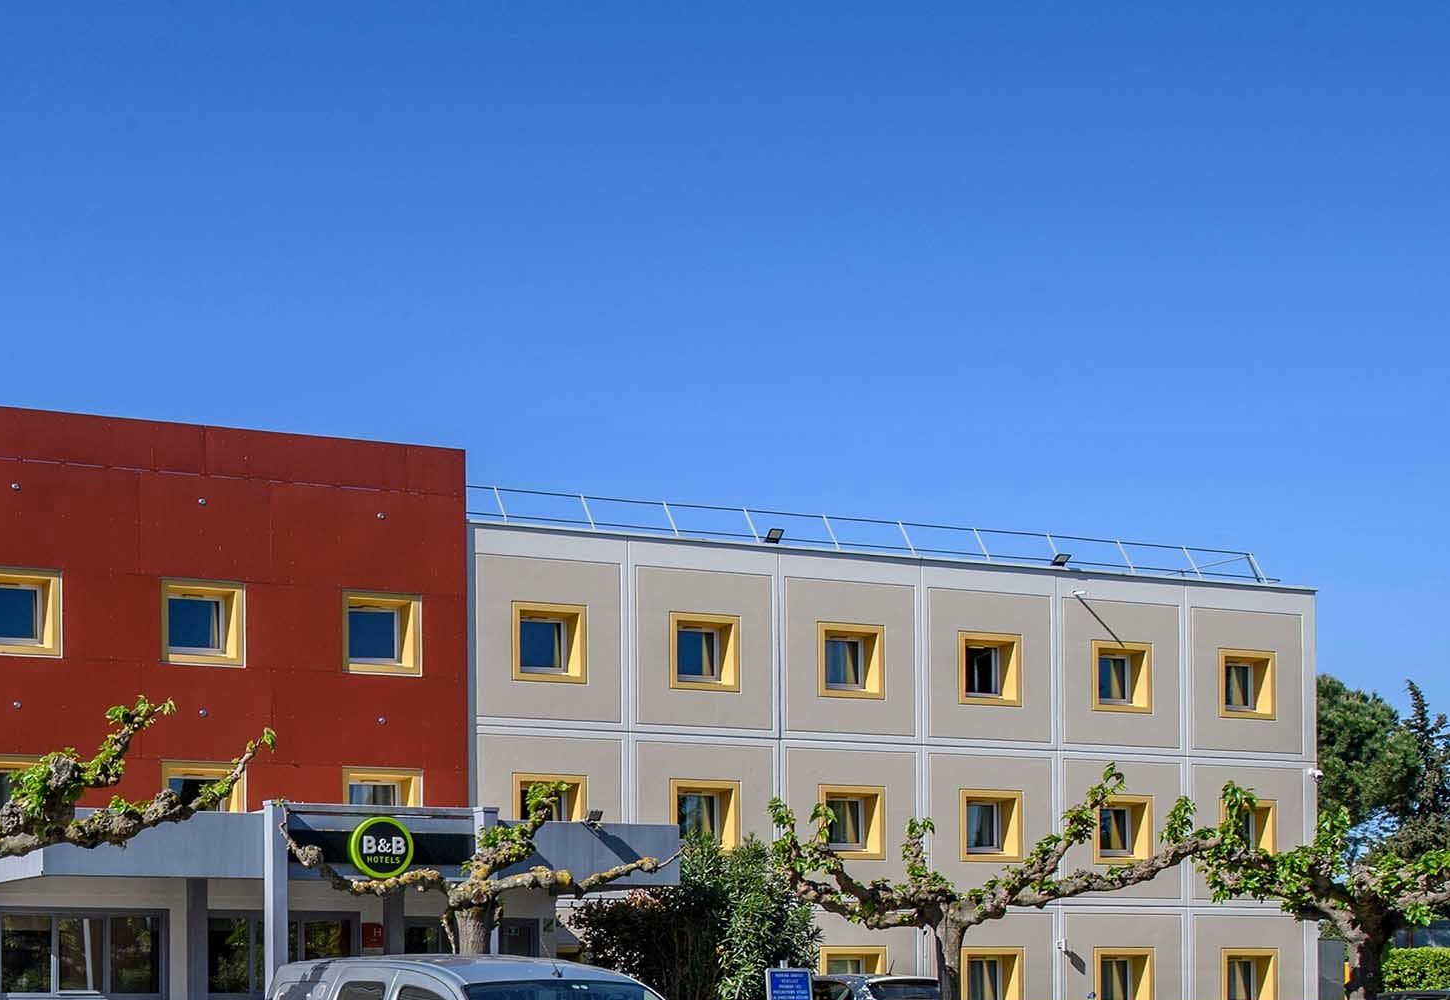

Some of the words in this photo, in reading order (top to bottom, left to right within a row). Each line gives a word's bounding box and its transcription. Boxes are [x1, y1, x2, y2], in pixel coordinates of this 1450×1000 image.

[363, 835, 406, 855] B&B
[366, 855, 401, 864] HOTELS
[373, 928, 382, 937] H
